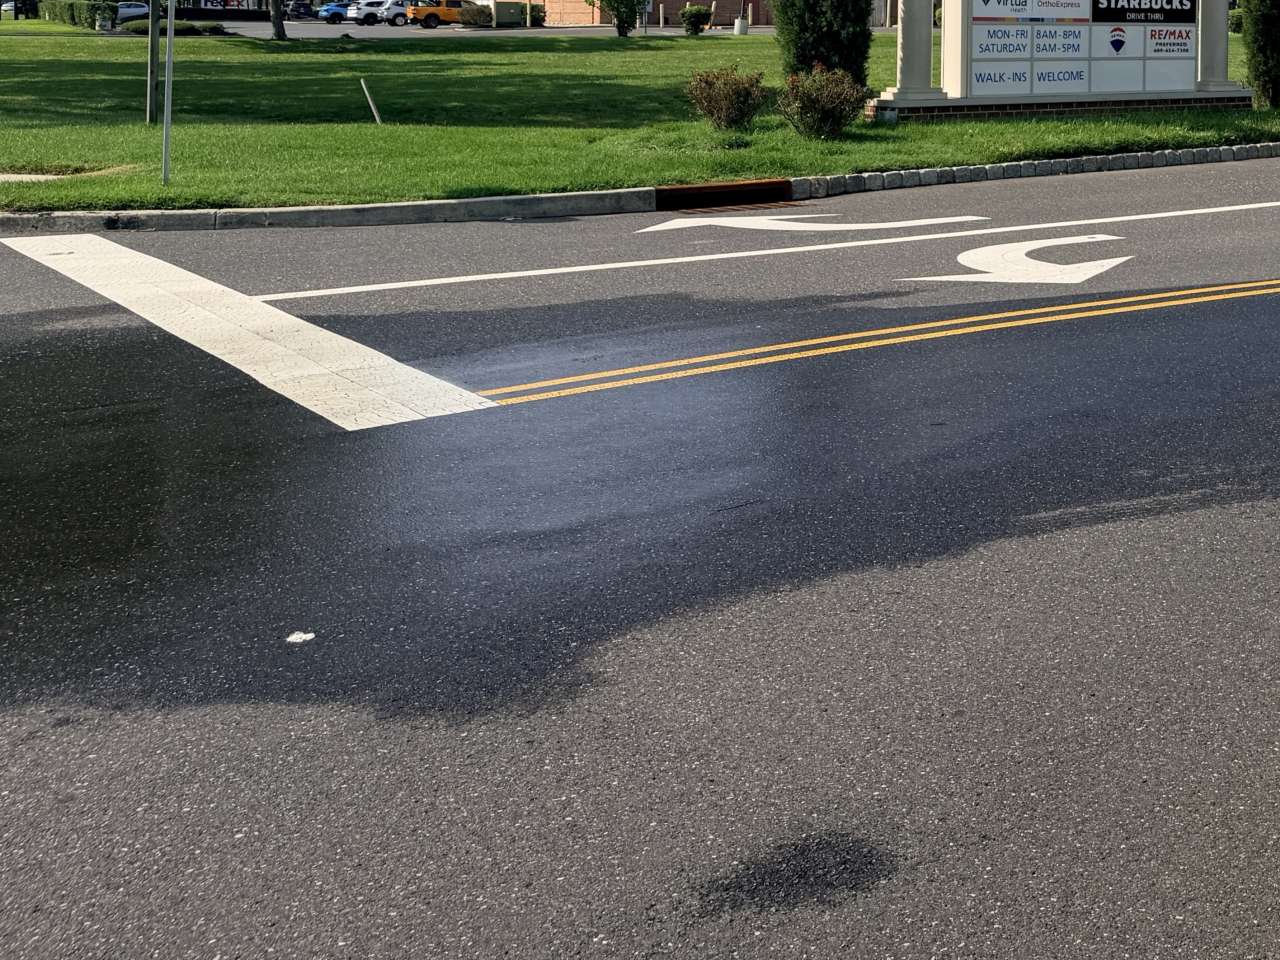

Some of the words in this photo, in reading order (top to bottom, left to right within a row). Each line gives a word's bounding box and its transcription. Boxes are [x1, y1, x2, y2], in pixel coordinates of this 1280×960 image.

[1037, 0, 1080, 9] OrthoExpress
[1126, 12, 1145, 20] DRIVE
[1147, 13, 1164, 21] THRU
[1150, 29, 1191, 40] RE/MAX
[979, 43, 1027, 53] SATURDAY
[1037, 71, 1084, 82] WELCOME
